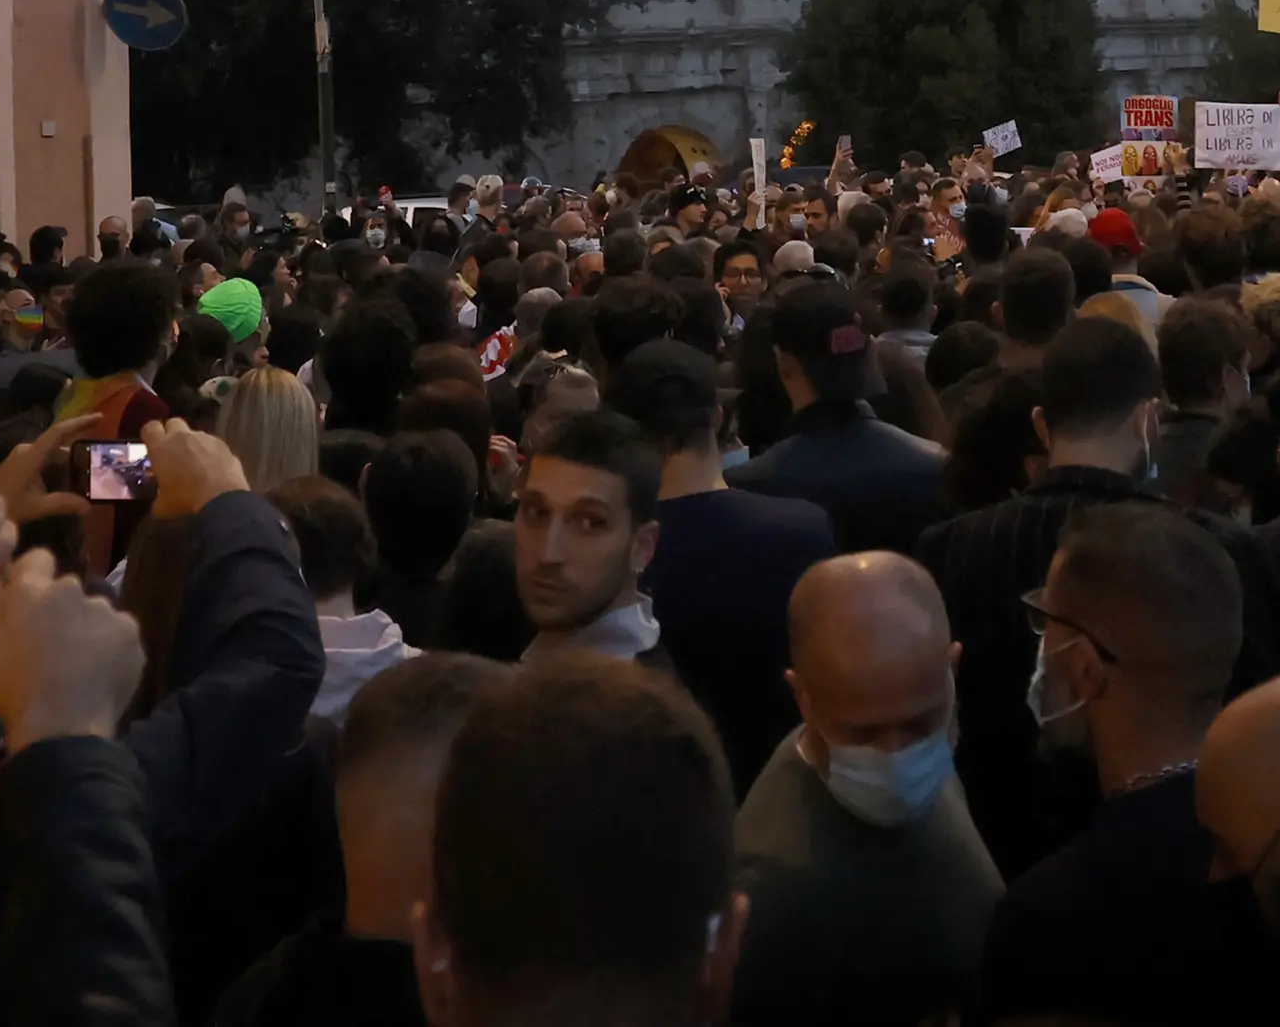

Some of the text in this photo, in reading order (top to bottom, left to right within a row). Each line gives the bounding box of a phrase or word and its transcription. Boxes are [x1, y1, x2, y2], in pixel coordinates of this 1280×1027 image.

[1124, 98, 1174, 110] ORGOGLIO
[1124, 110, 1174, 127] TRANS
[1262, 111, 1273, 124] DI
[1109, 153, 1122, 162] NO
